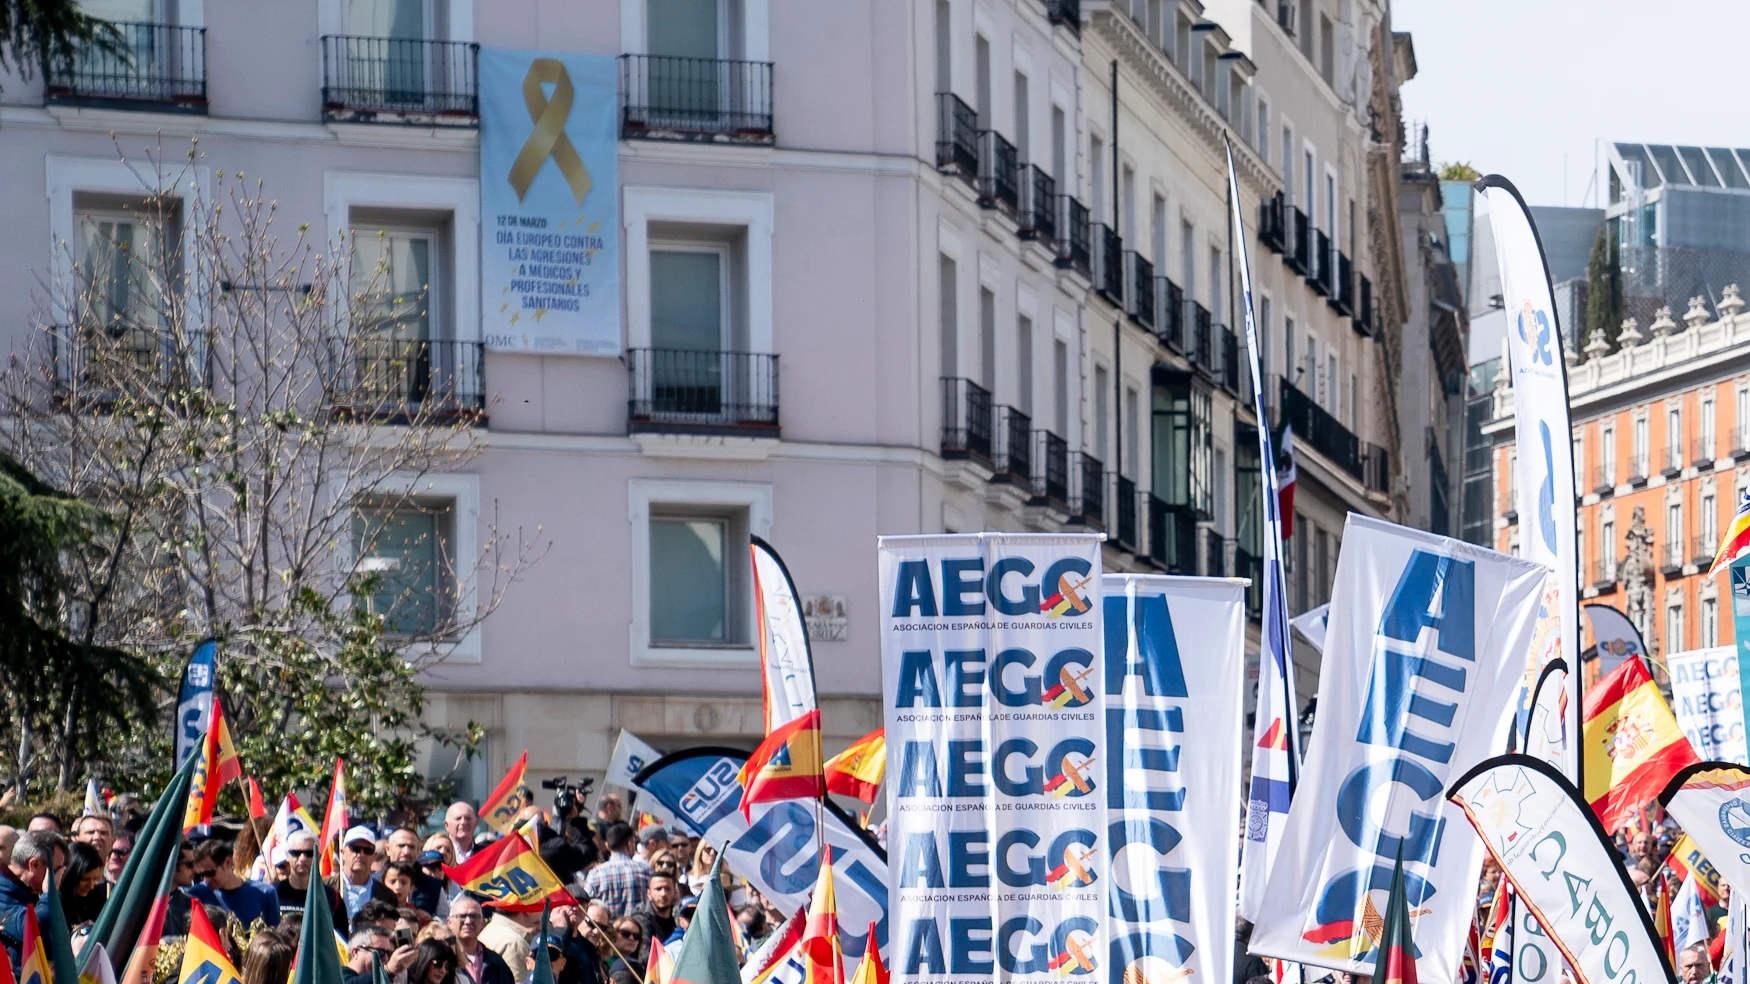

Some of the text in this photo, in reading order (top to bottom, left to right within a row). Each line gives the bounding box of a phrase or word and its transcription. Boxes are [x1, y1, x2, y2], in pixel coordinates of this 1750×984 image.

[497, 215, 547, 229] 12 DE MARZO
[497, 231, 603, 250] DÍA EUROPEO CONTRA
[508, 248, 592, 266] LAS AGRESIONES
[518, 263, 582, 281] A MÉDICOS Y
[510, 279, 590, 298] PROFESIONALES
[522, 295, 580, 313] SANITARIOS
[891, 555, 1093, 618] AEGC
[892, 620, 1093, 632] ASOCIACION ESPAÑOLA DE GUARDIAS CIVILES
[895, 646, 1094, 710] AEGC
[898, 736, 1097, 800] AEGC
[900, 828, 1099, 890] AEGC
[901, 914, 1099, 977] AEGC
